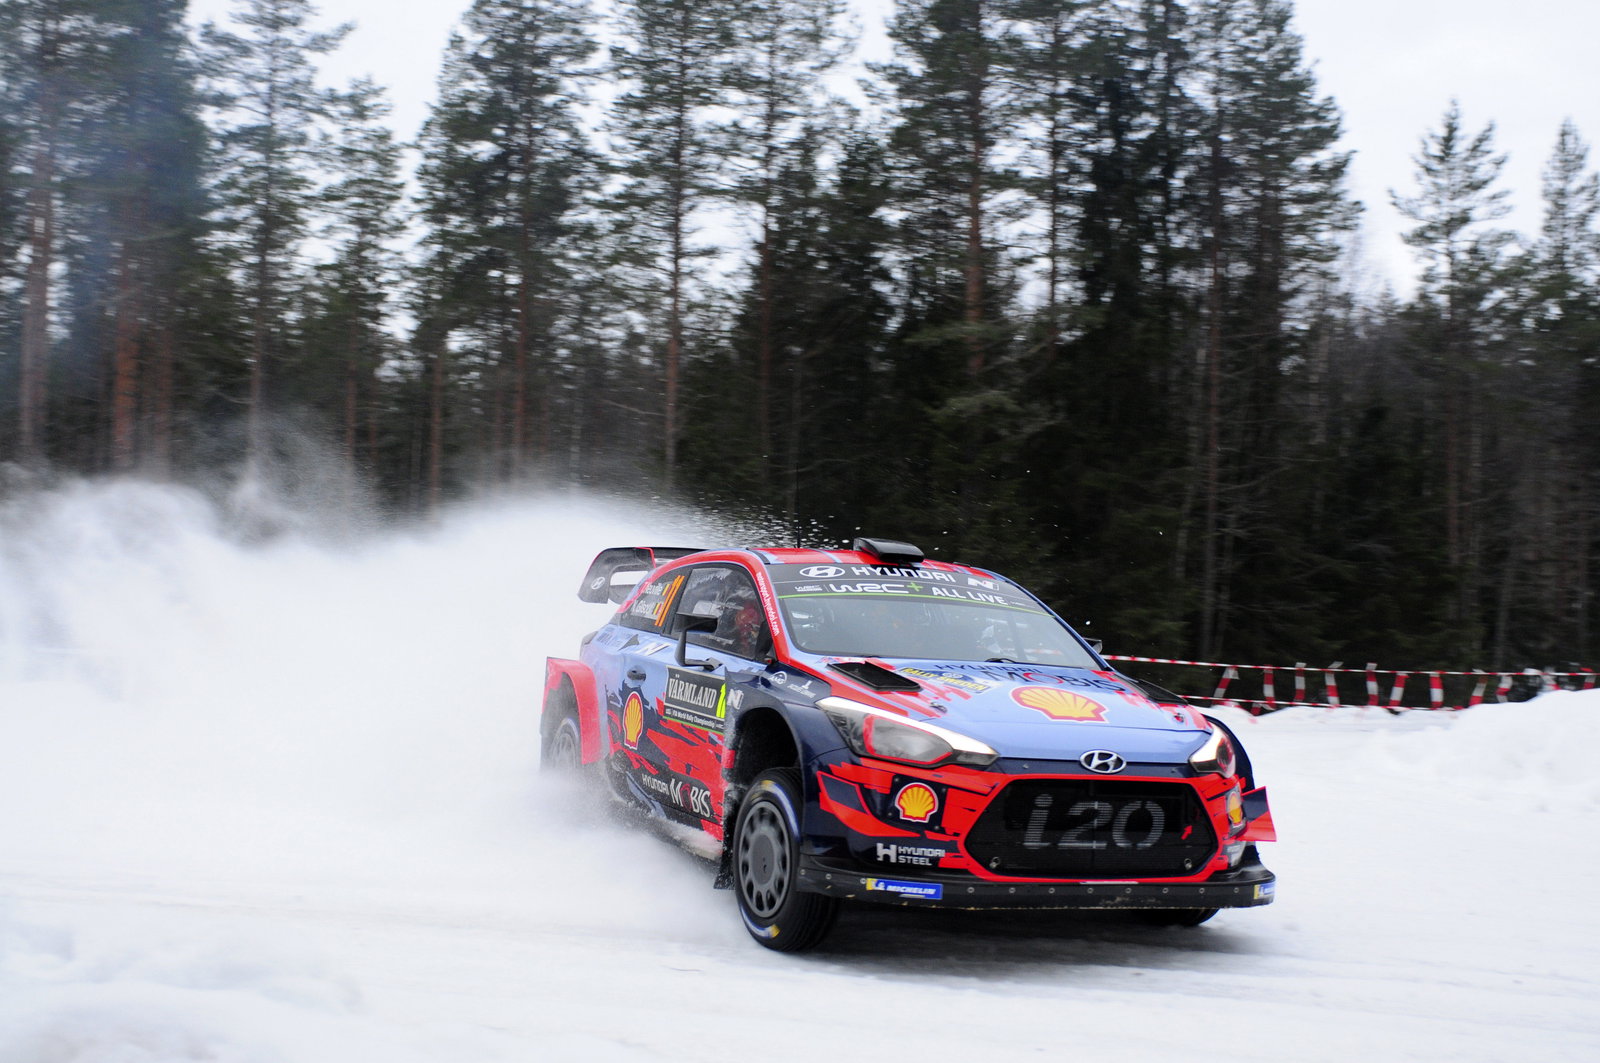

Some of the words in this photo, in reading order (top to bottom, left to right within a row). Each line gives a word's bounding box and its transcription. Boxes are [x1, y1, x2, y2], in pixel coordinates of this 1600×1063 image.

[850, 566, 957, 583] HYUNDAI
[931, 586, 967, 599] ALL
[967, 591, 1009, 606] LIVE
[903, 667, 939, 678] RALLY
[936, 676, 987, 692] SWEDEN
[934, 664, 1043, 674] HYUNDAI
[668, 673, 718, 709] VÄRMLAND
[980, 670, 1126, 692] MOBIS
[669, 778, 711, 818] MOBIS
[1023, 793, 1166, 850] i20
[897, 846, 946, 858] HYUNDAI
[897, 855, 932, 866] STEEL
